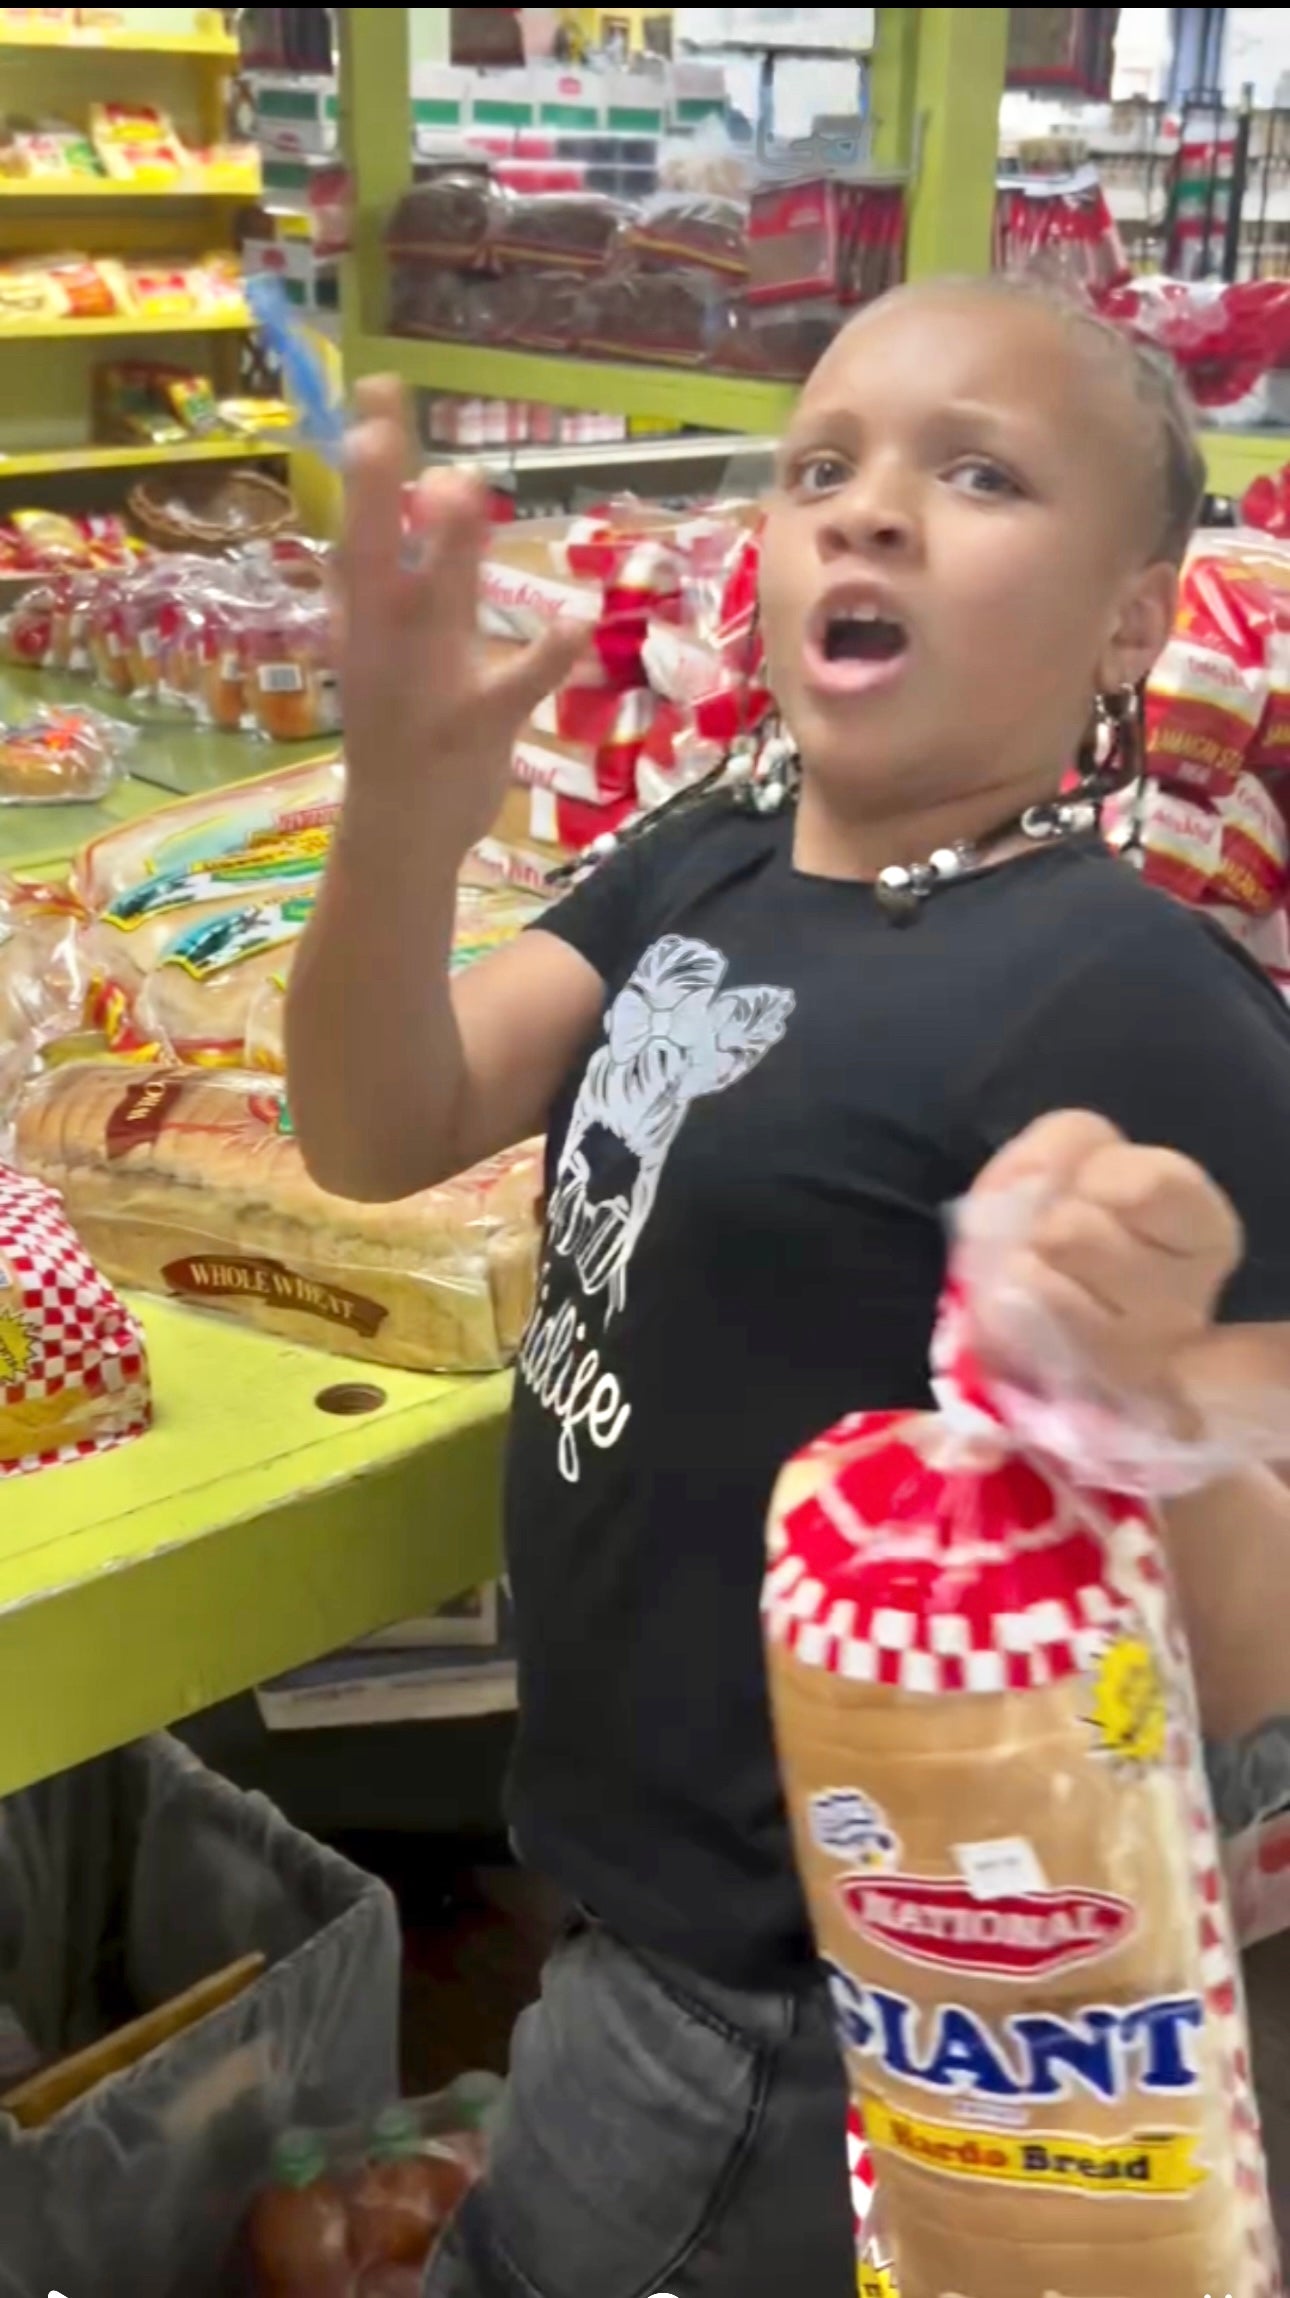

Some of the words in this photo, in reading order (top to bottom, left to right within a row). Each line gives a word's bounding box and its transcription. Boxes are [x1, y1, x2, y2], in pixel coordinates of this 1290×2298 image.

[189, 1263, 271, 1294] WHOLE
[271, 1273, 356, 1320] WHEAT
[859, 1890, 1106, 1950] NATIONAL
[1019, 2144, 1150, 2182] Bread
